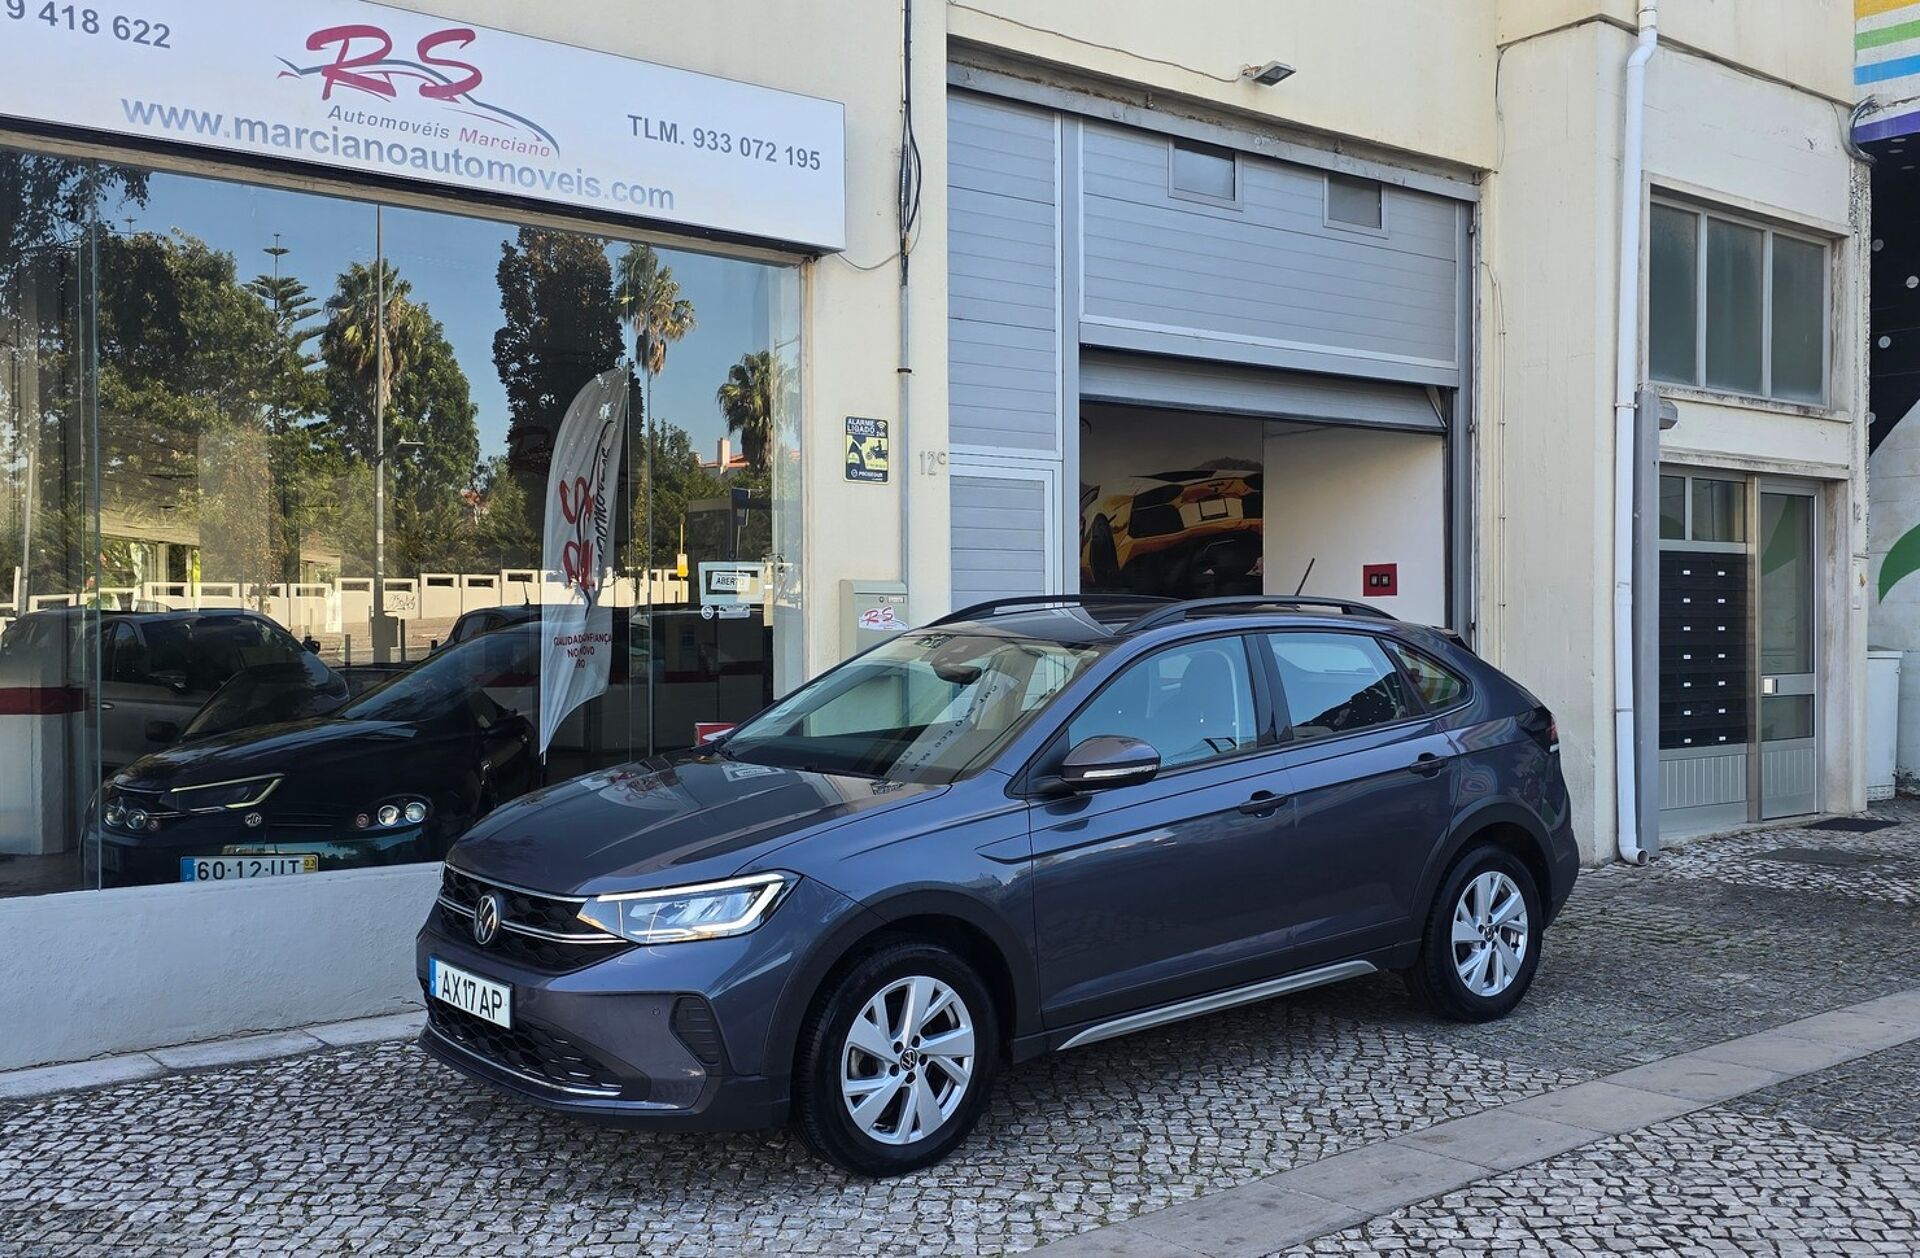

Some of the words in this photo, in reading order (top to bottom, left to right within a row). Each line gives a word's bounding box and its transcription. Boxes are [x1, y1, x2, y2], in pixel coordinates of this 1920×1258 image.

[38, 1, 100, 35] 418
[112, 15, 171, 49] 622
[305, 24, 483, 101] RS
[121, 98, 675, 211] www.marcianoautomoveis.com
[458, 127, 551, 158] Marciano
[627, 114, 685, 146] TLM.
[693, 127, 732, 154] 933
[740, 137, 777, 163] 072
[785, 146, 821, 171] 195
